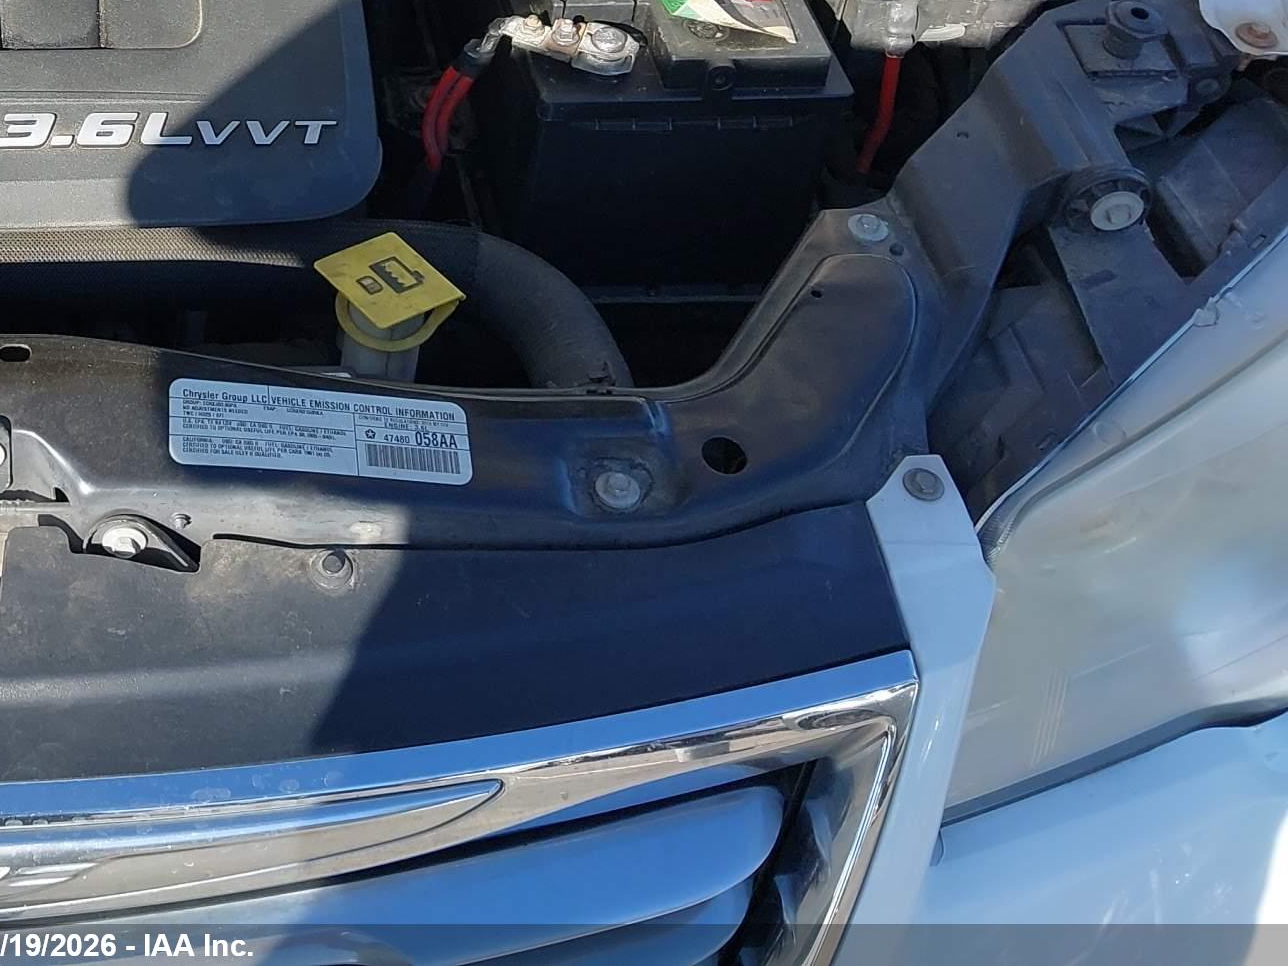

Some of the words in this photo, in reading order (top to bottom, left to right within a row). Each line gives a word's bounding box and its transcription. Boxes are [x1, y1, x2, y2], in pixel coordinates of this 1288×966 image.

[183, 388, 219, 400] Chrysler
[221, 392, 248, 403] Group
[251, 394, 267, 403] LLC
[271, 396, 306, 407] VEHICLE
[309, 400, 351, 411] EMISSION
[354, 404, 392, 415] CONTROL
[396, 408, 455, 420] INFORMATION
[415, 430, 457, 449] 058AA
